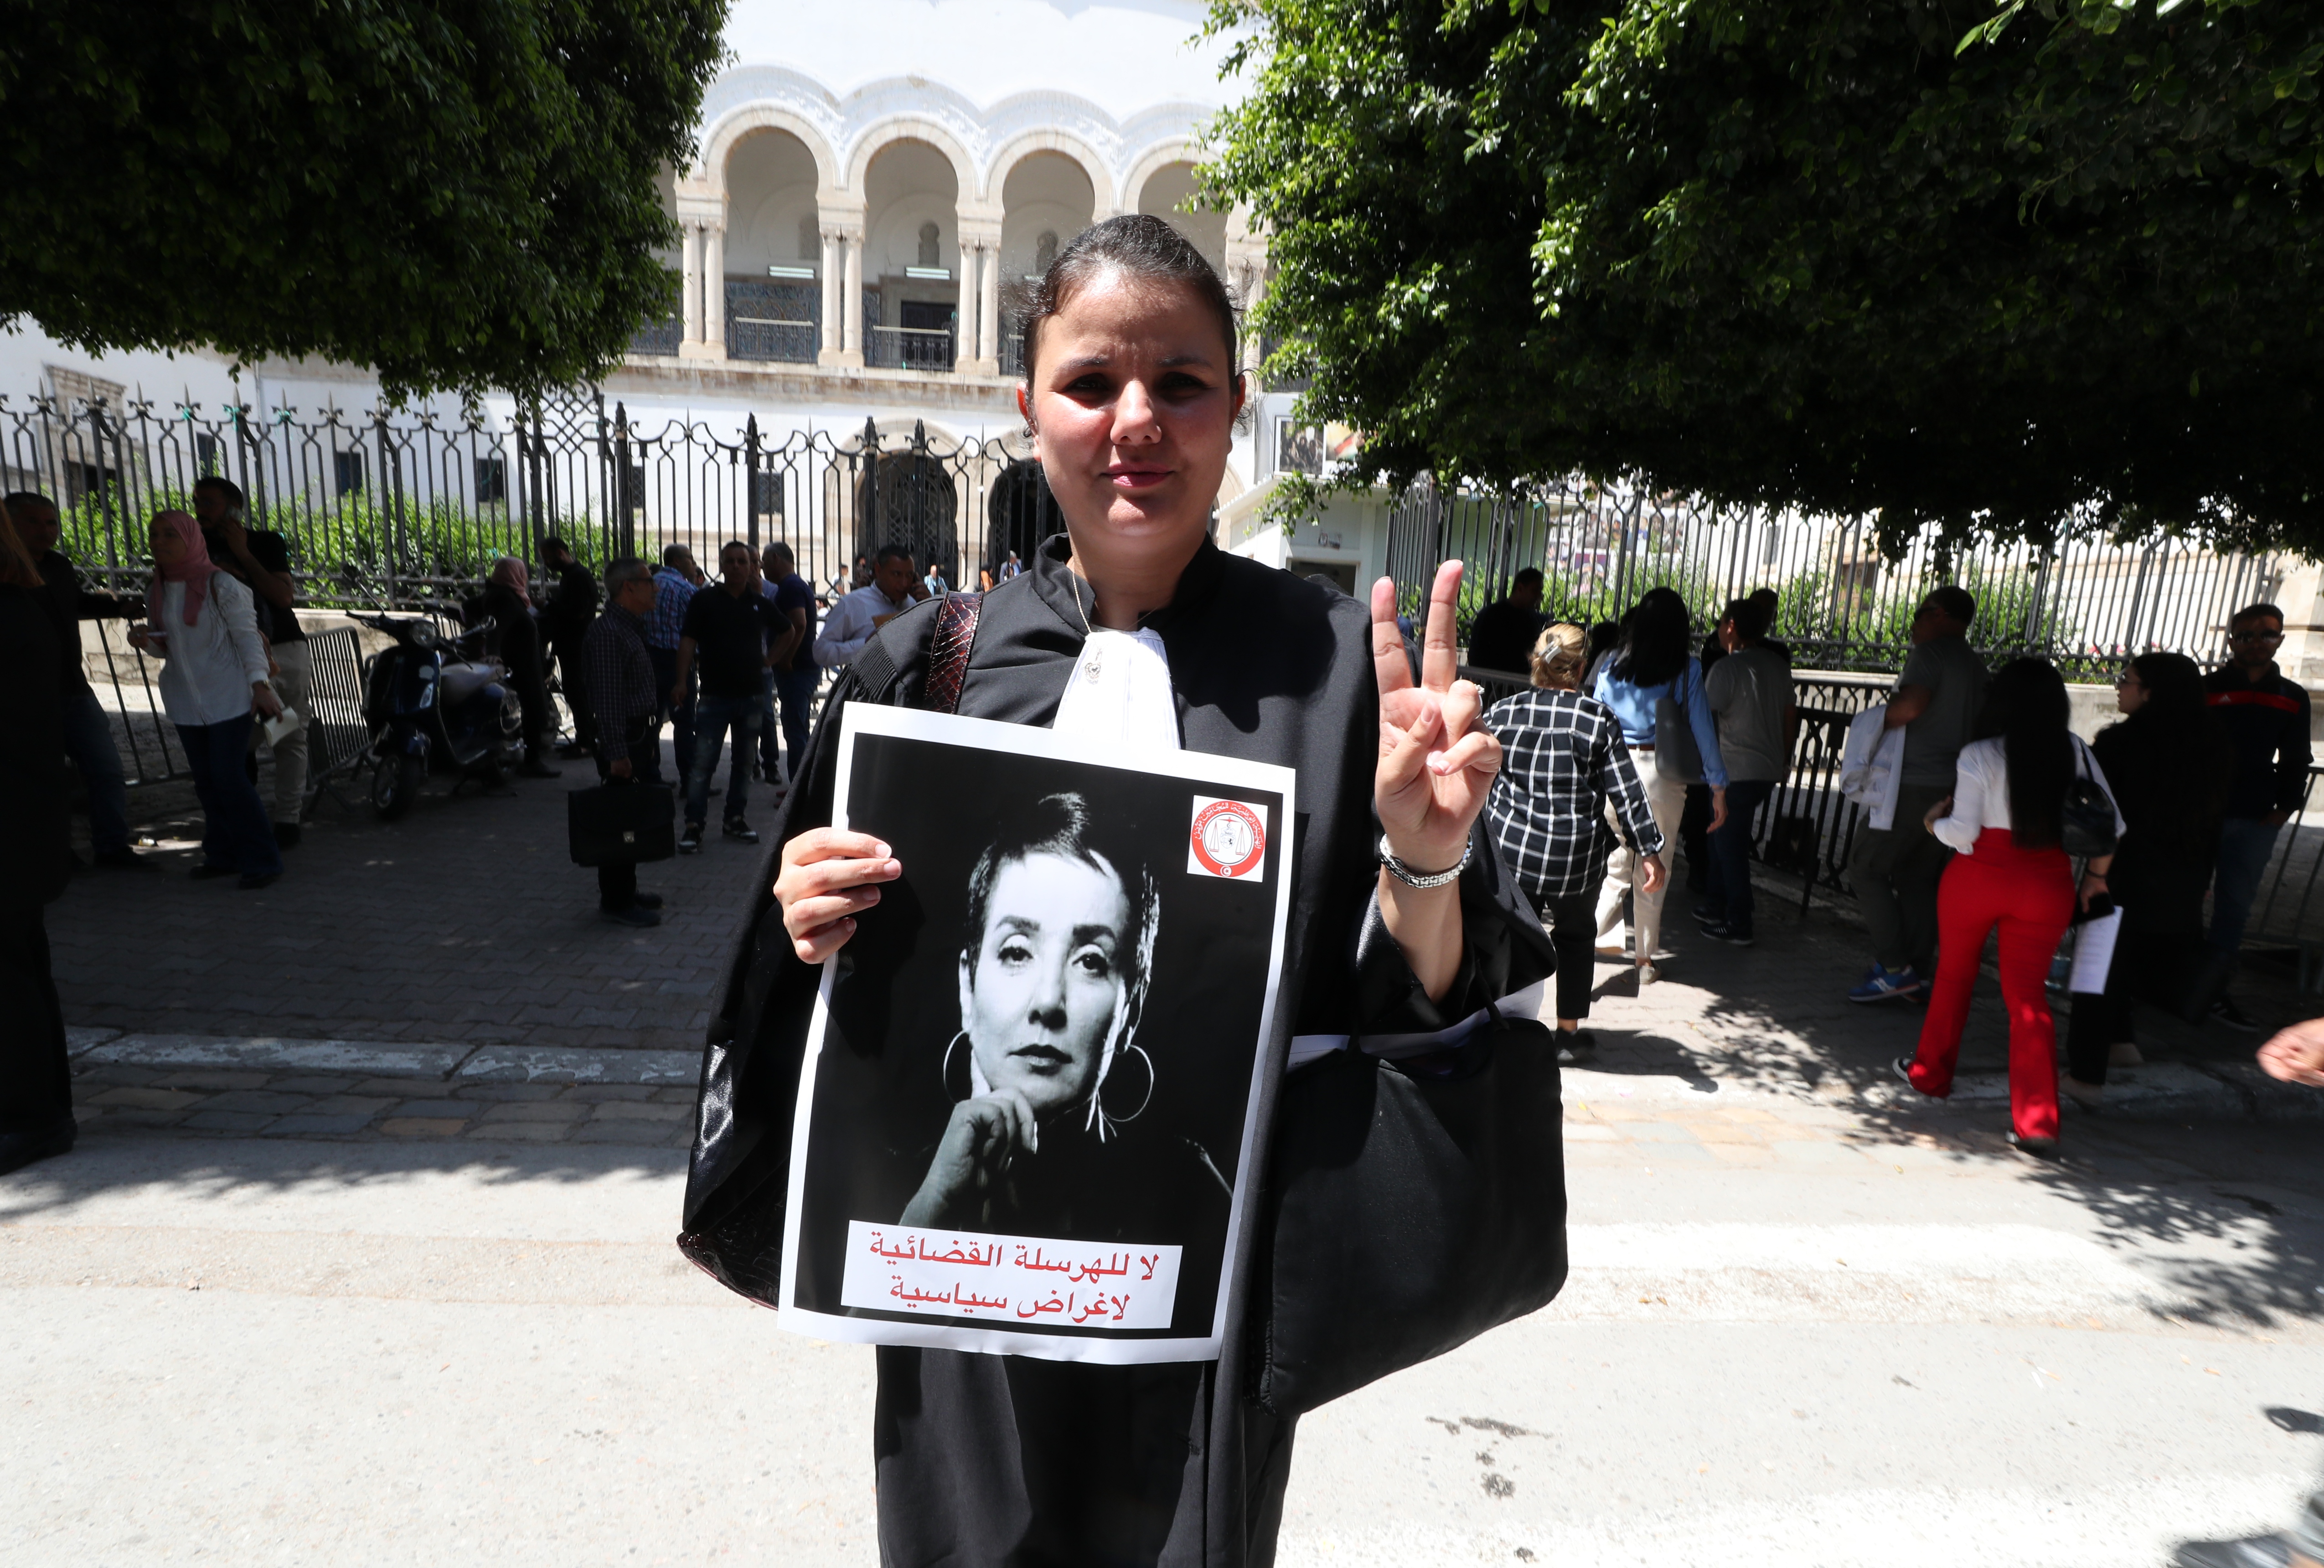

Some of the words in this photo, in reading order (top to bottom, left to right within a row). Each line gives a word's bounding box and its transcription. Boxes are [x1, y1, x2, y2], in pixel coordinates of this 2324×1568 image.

[870, 1232, 1002, 1267] القضائية
[1014, 1245, 1130, 1284] للهرسلة
[1140, 1254, 1159, 1280] لا
[890, 1275, 1007, 1313] سياسية
[1017, 1290, 1131, 1323] لاغراض
